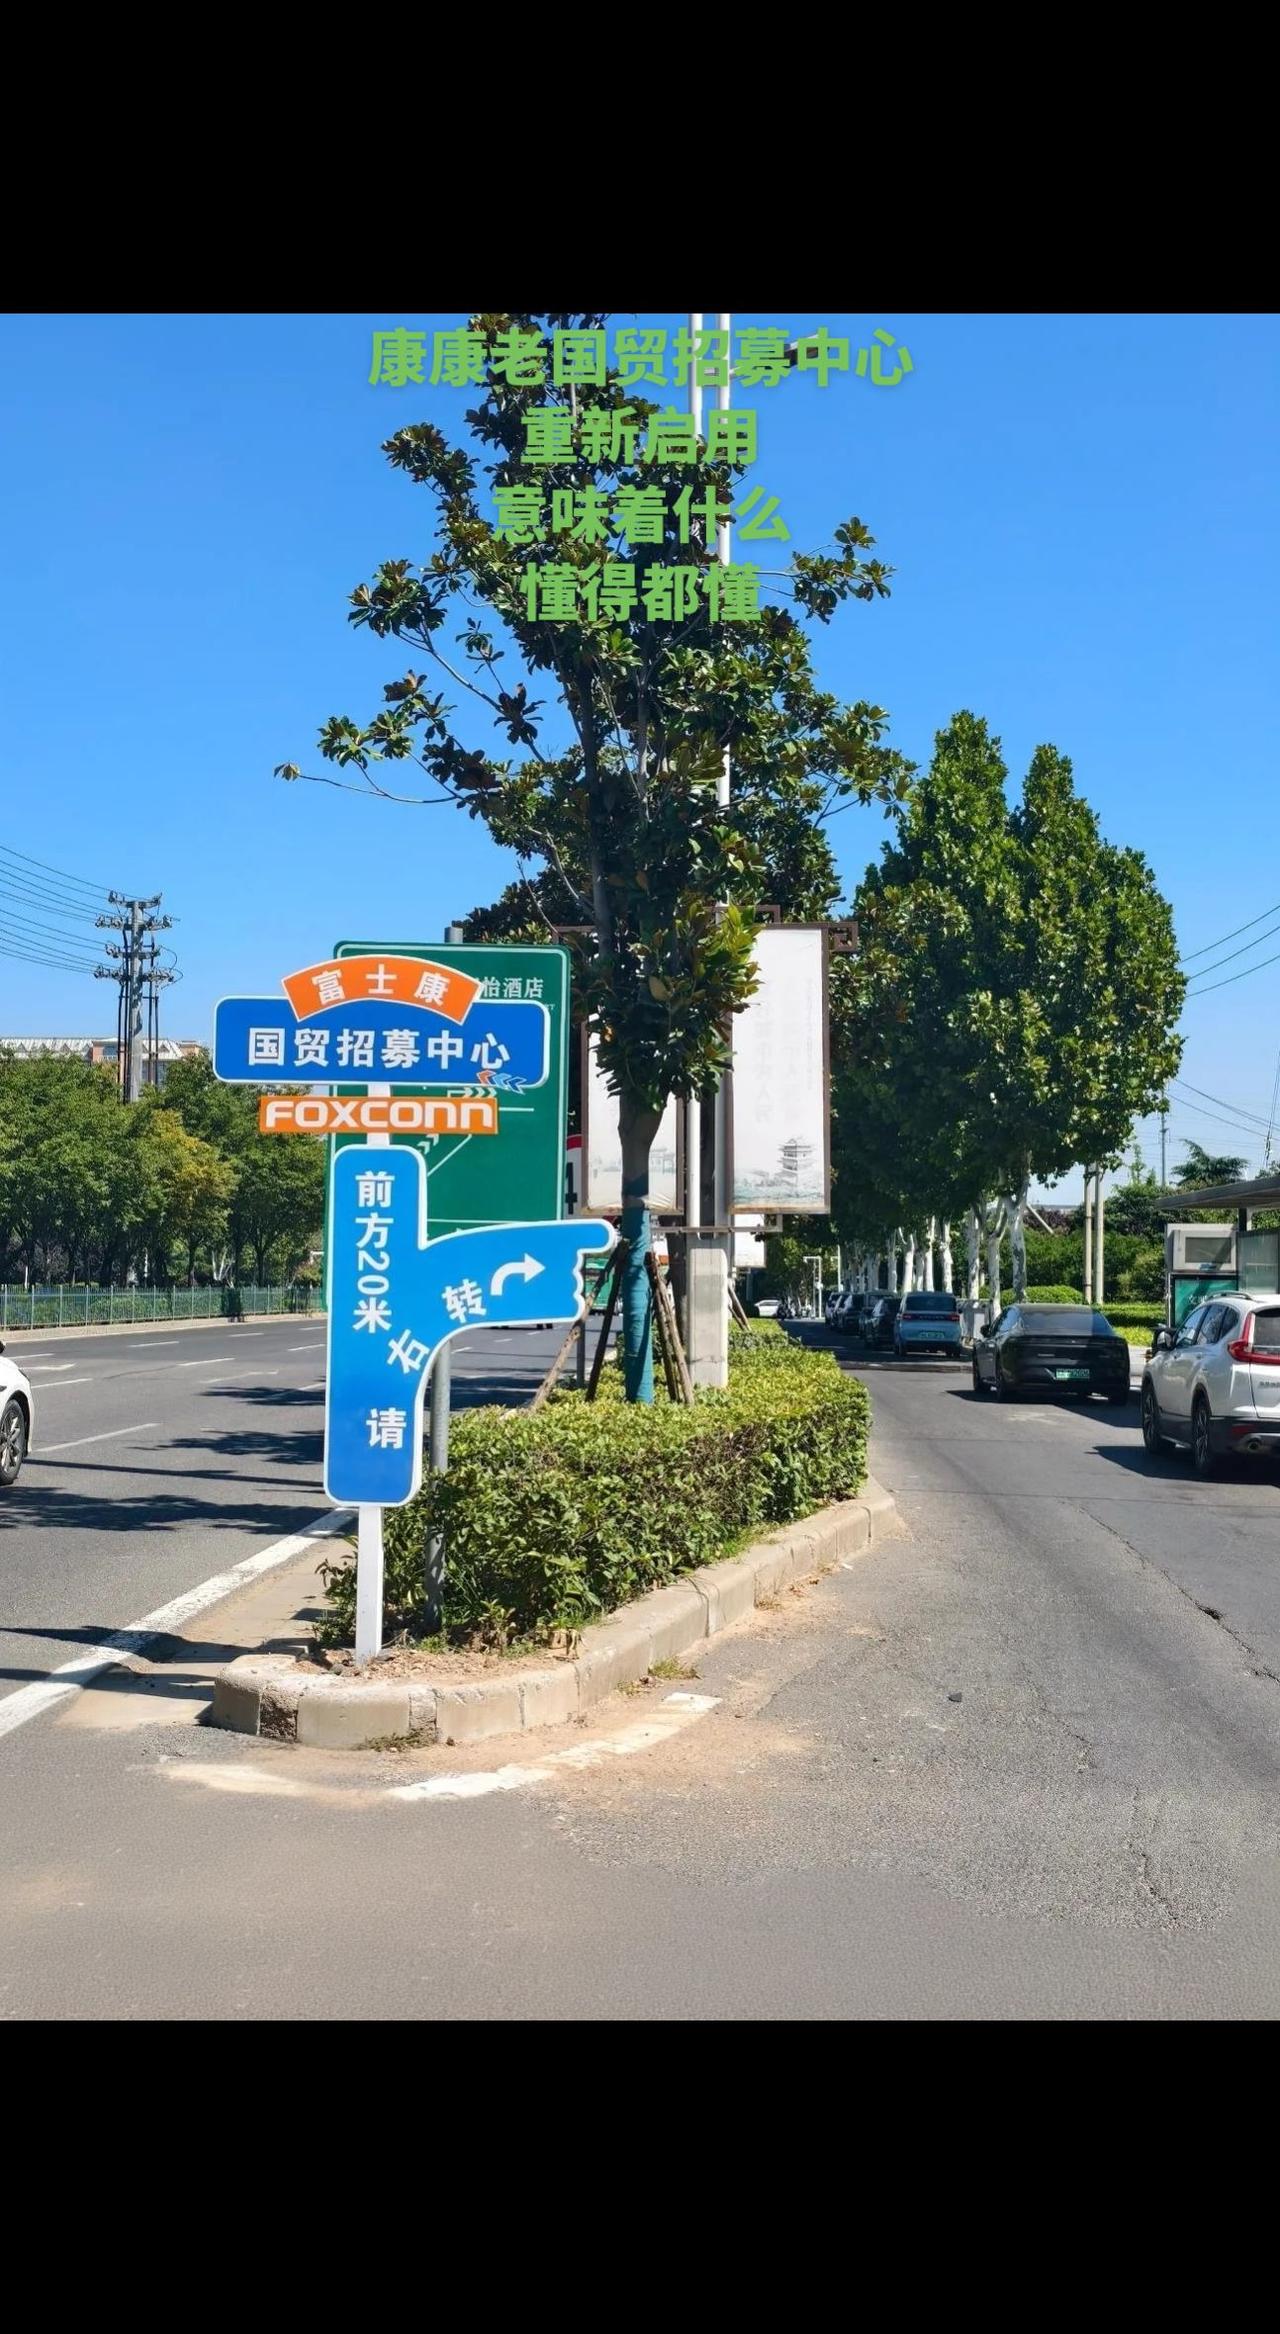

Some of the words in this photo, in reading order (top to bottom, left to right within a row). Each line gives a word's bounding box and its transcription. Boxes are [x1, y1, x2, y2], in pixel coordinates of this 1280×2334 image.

[311, 963, 450, 1006] 富士康
[475, 976, 544, 998] 怡酒店
[248, 1027, 511, 1070] 国贸招募中心
[353, 1170, 395, 1334] 前方20米
